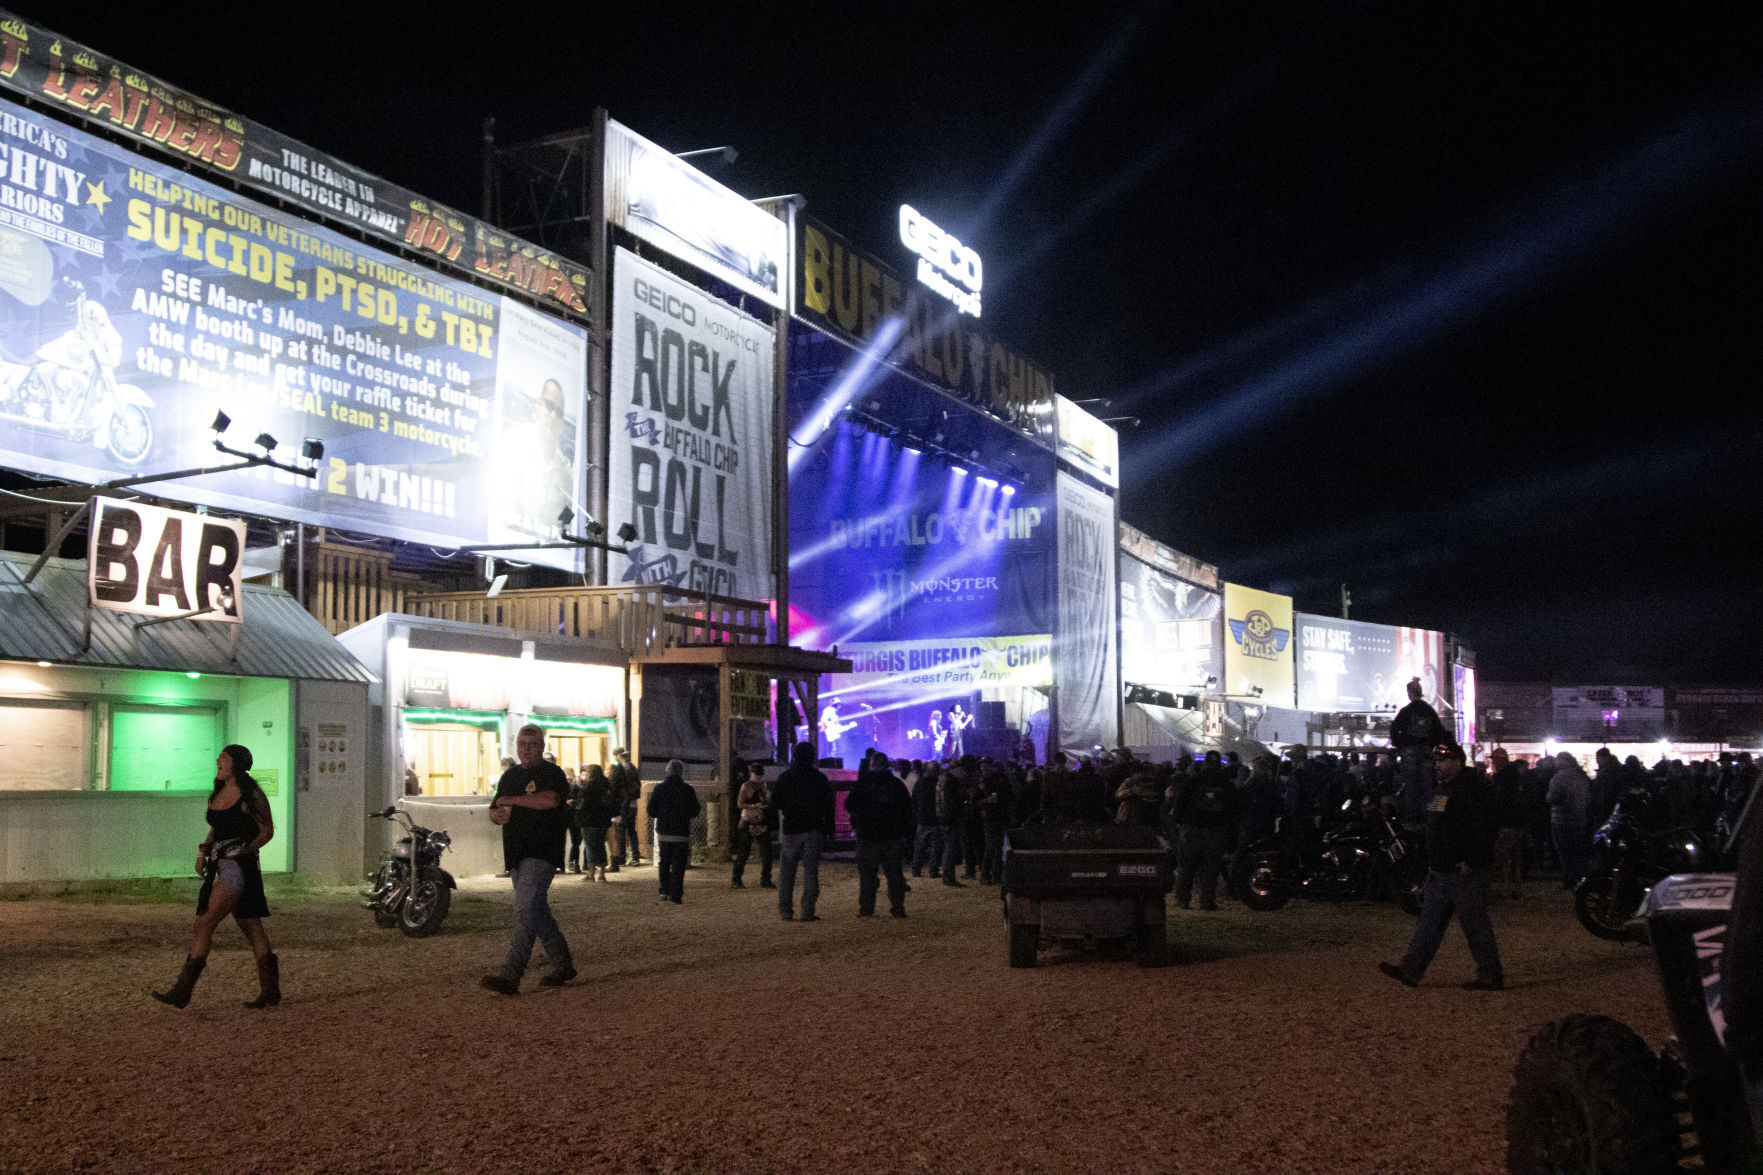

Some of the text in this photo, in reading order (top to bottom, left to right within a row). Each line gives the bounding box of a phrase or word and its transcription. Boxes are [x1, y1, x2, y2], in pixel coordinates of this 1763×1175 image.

[0, 111, 67, 159] RICA'S
[43, 50, 244, 171] LEATHERS
[249, 158, 400, 234] MOTORCYCLE APPAREL
[281, 149, 375, 203] THE LEADER IN
[129, 167, 493, 320] HELPING OUR VETERANS STRUGGLING WITH
[404, 205, 465, 261] HOT
[900, 204, 982, 291] GEICO
[127, 198, 308, 300] SUICIDE,
[316, 267, 408, 335] PTSD,
[415, 303, 436, 340] &
[441, 311, 493, 359] TBI
[634, 277, 697, 328] GEICO
[131, 287, 488, 419] AMW booth up at the Crossroads during
[161, 269, 471, 387] SEE Marc's Mom, Debbie Lee at the
[136, 346, 173, 378] the
[330, 401, 374, 430] team
[379, 410, 389, 433] 3
[149, 321, 479, 433] the day and get your raffle ticket for
[631, 311, 738, 444] ROCK
[327, 456, 348, 496] 2
[356, 462, 457, 518] WIN!!!
[714, 442, 739, 474] CHIP
[631, 445, 738, 567] ROLL
[831, 506, 1042, 549] BUFFALO CHIP
[96, 505, 240, 617] BAR
[909, 575, 1000, 594] MONSTER
[923, 594, 986, 603] ENERGY
[908, 645, 982, 672] BUFFALO
[1006, 643, 1050, 668] CHIP
[1241, 631, 1279, 661] CYCLES
[1302, 625, 1355, 655] STAY SAFE,
[944, 670, 976, 685] Party
